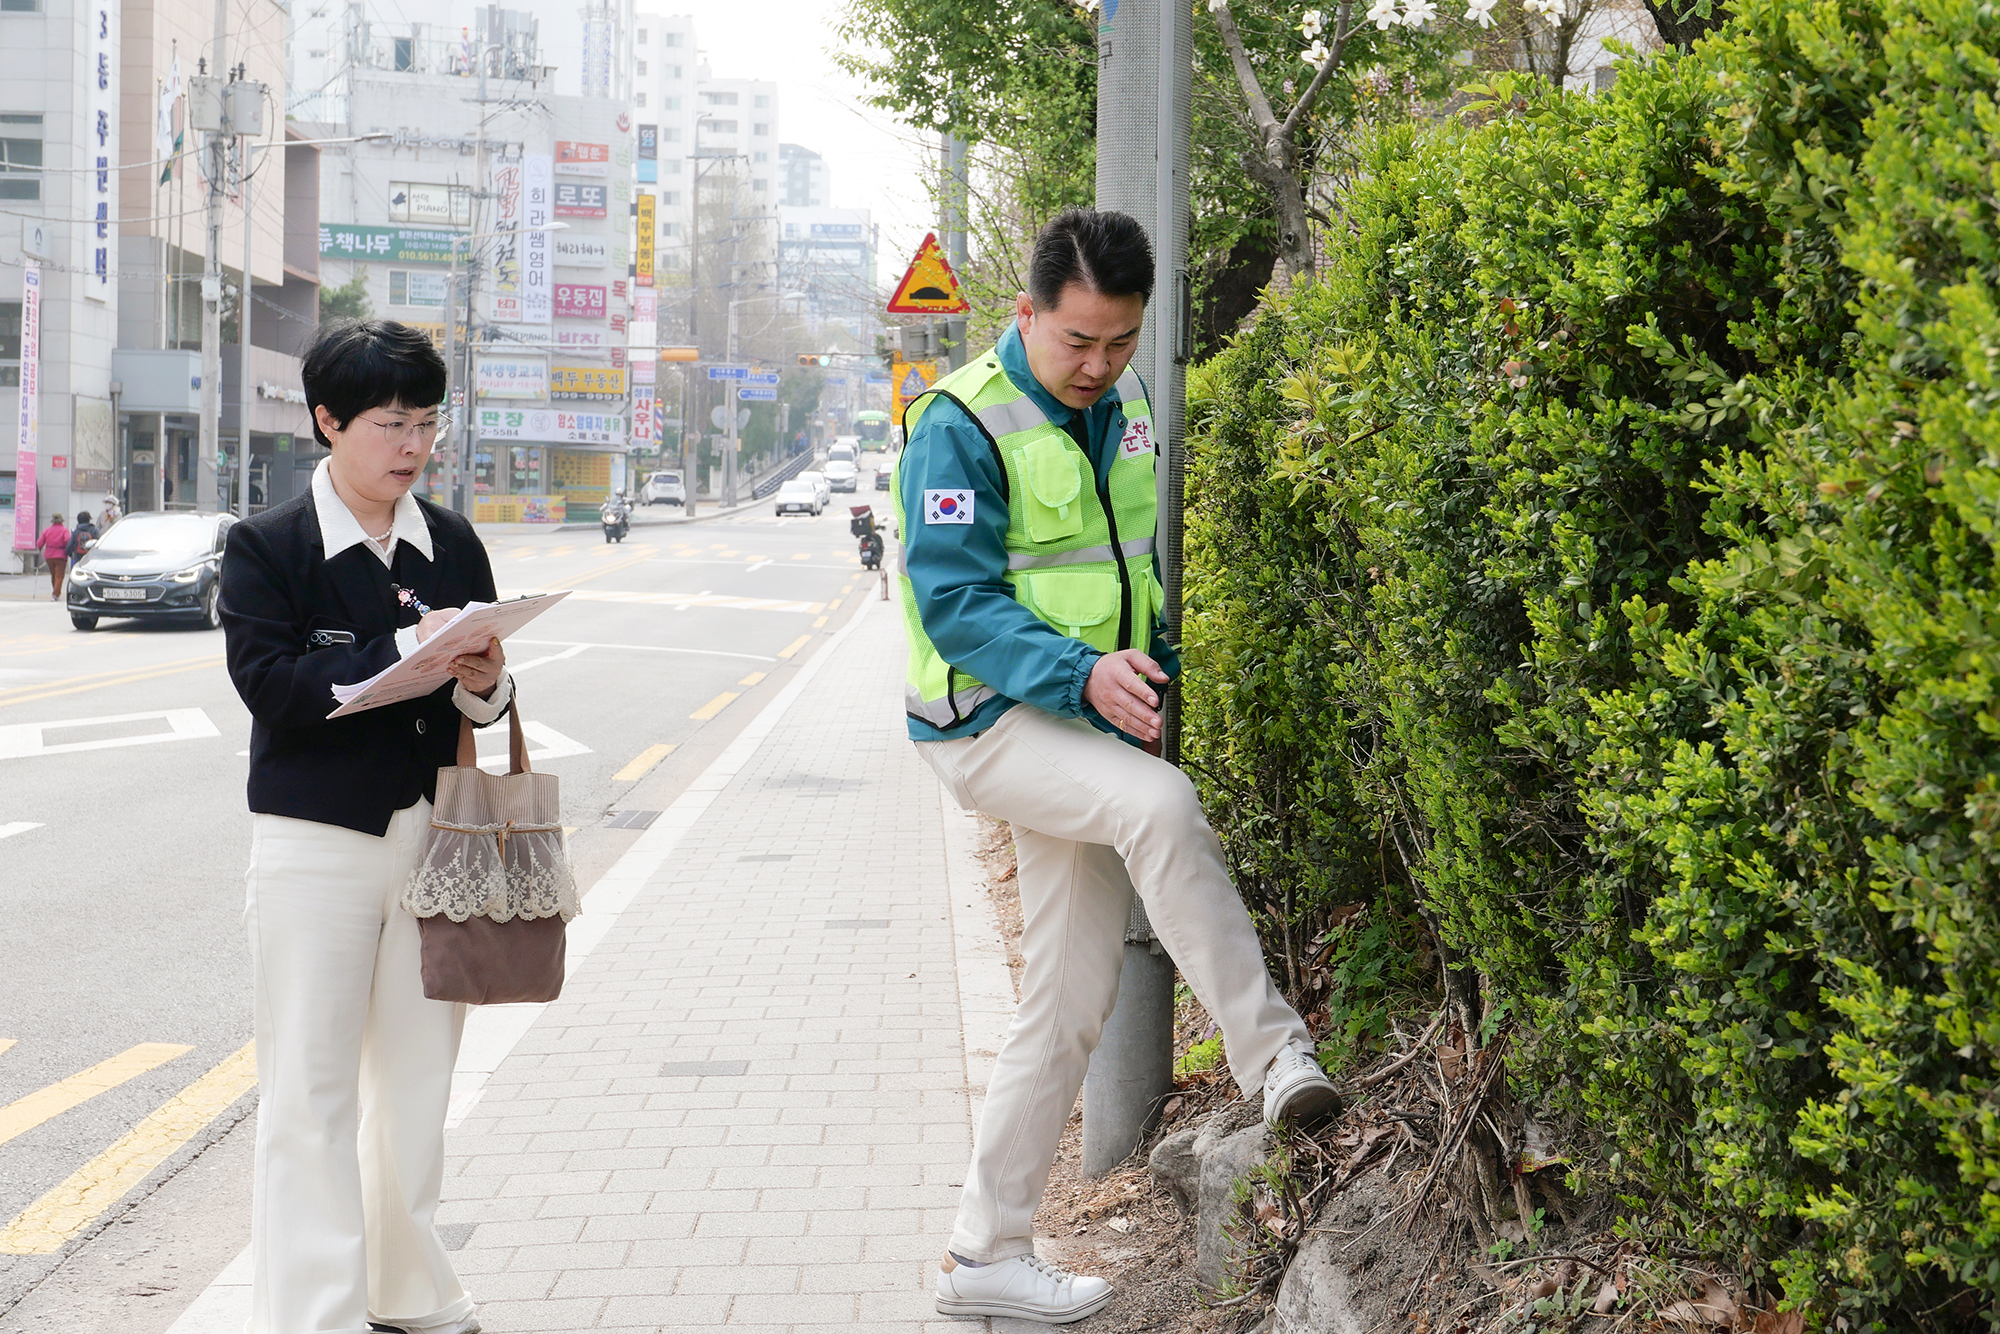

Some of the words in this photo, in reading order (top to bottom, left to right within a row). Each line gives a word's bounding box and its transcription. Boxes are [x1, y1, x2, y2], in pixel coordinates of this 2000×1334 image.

[641, 129, 655, 138] GS
[641, 137, 655, 147] 25
[577, 145, 601, 160] 웹툰
[556, 185, 602, 207] 로또
[416, 204, 448, 213] PIANO
[335, 231, 391, 255] 책나무
[638, 207, 653, 273] 백두부동산
[398, 250, 463, 263] 010.5613.491
[557, 286, 603, 307] 우동집
[520, 333, 548, 342] PIANO
[479, 363, 543, 379] 새생명교회
[552, 371, 579, 387] 백두
[582, 373, 620, 389] 부동산
[634, 388, 653, 398] 성원
[634, 399, 651, 440] 사우나
[1123, 421, 1152, 453] 순찰
